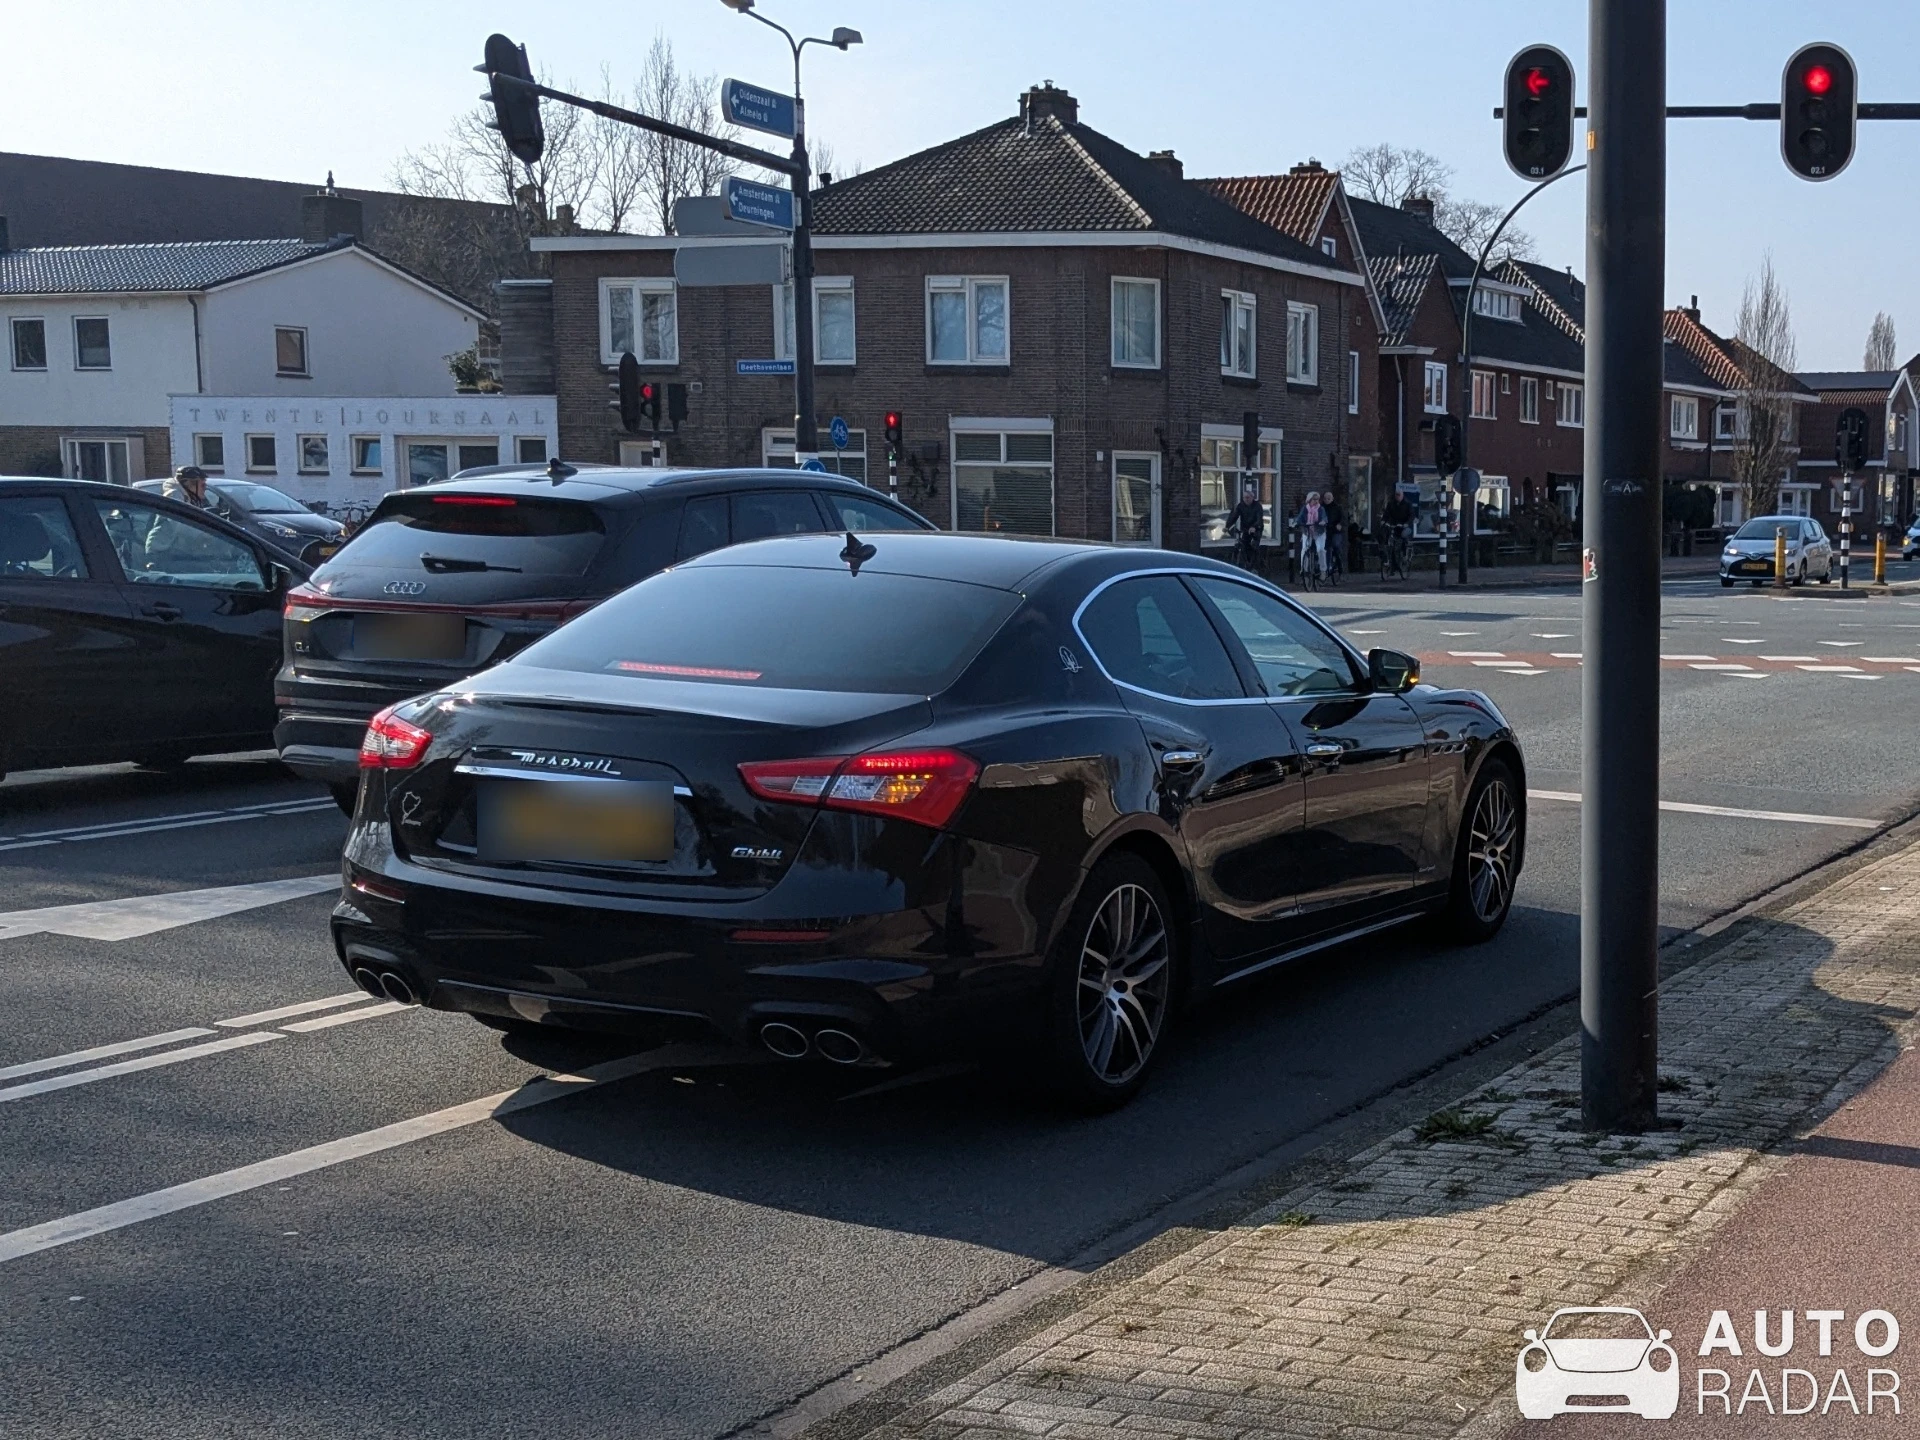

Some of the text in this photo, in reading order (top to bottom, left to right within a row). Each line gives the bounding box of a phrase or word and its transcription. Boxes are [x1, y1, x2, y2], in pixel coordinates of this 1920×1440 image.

[738, 185, 774, 203] Amsterdam
[189, 408, 544, 425] TWENTE JOURNAAL
[731, 847, 782, 859] Ghibli
